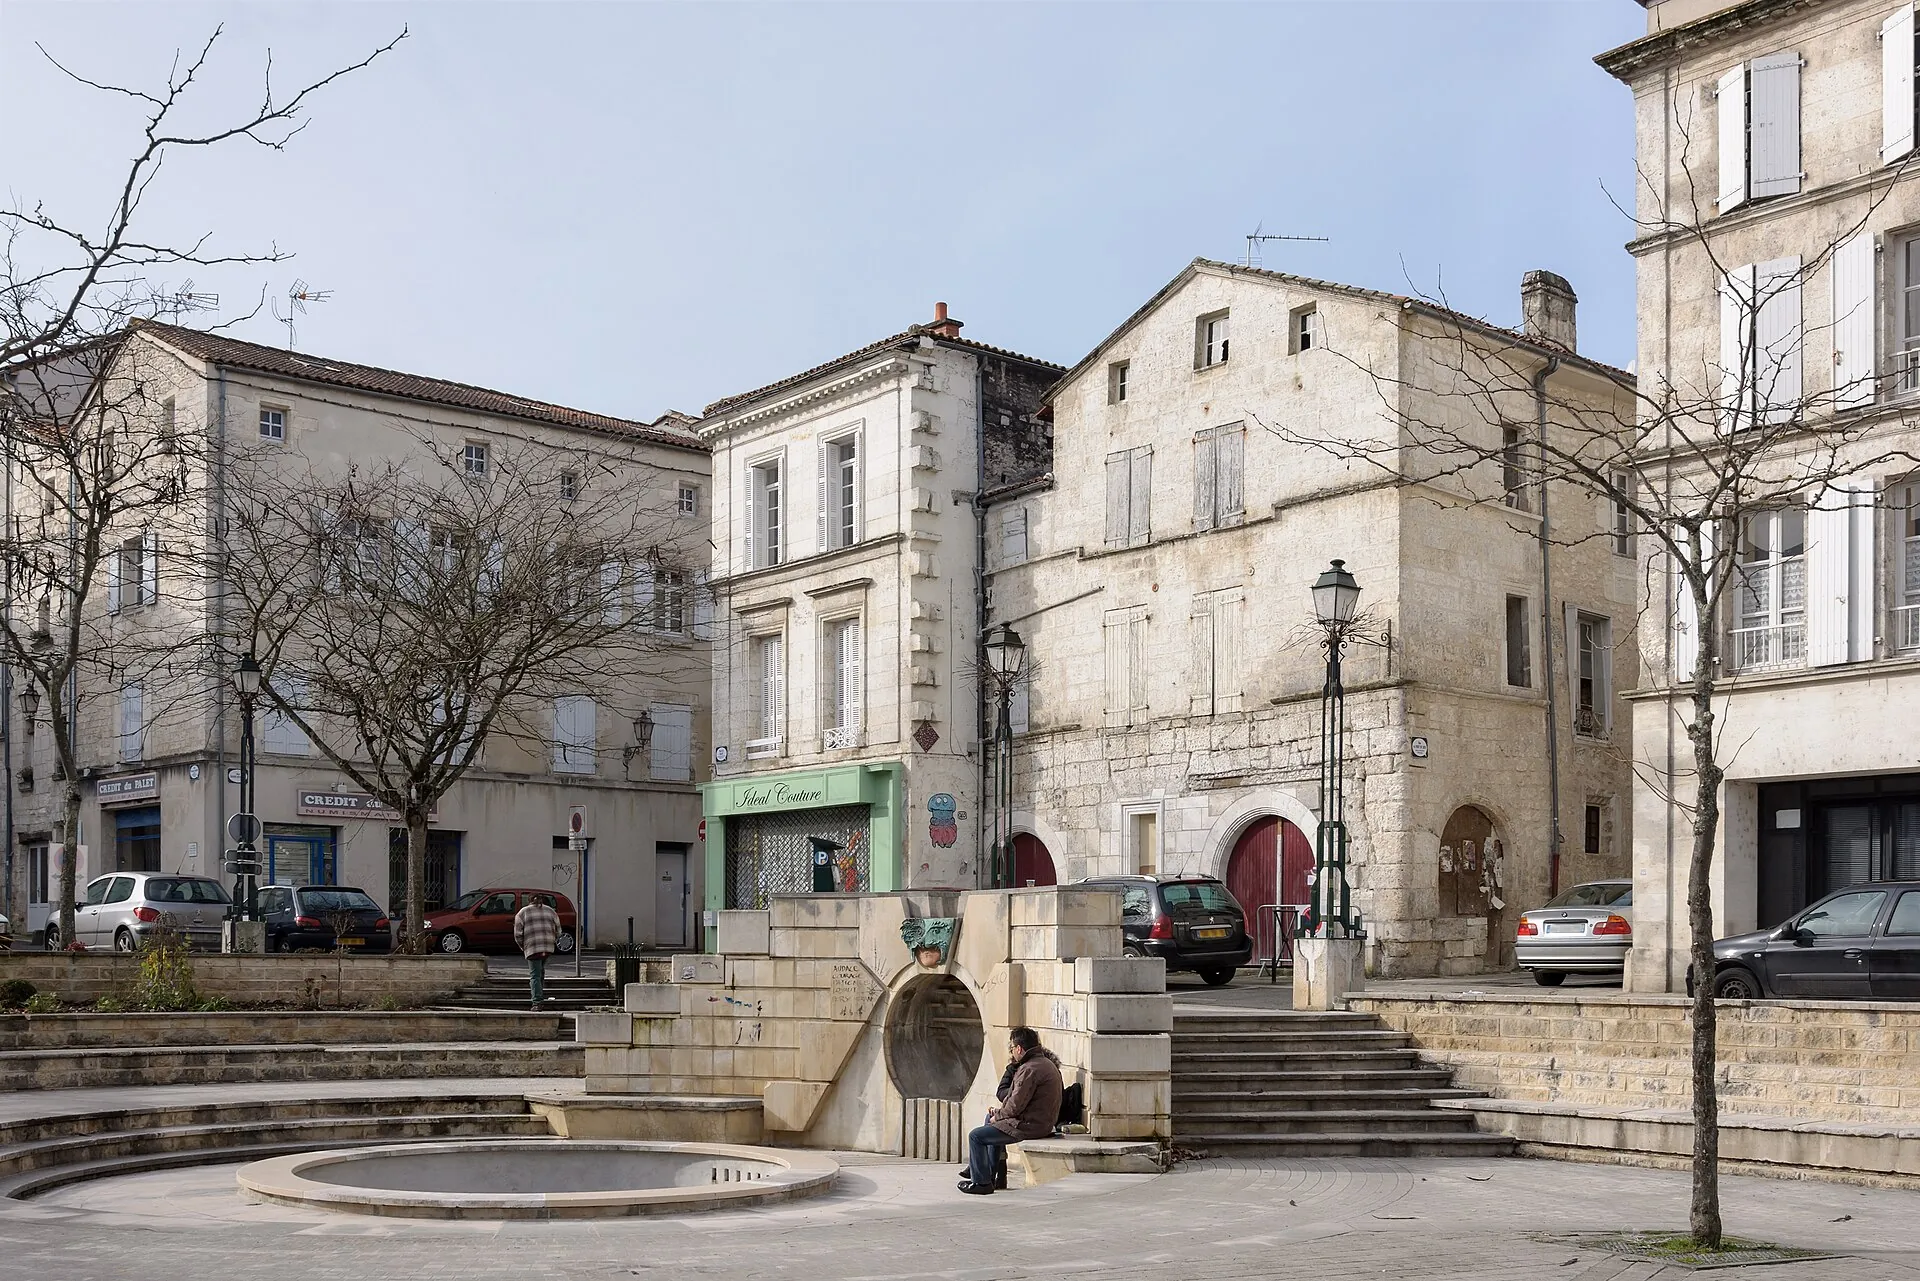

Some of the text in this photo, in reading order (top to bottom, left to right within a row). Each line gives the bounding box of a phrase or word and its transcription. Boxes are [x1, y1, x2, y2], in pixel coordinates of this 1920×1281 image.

[100, 778, 154, 794] CREDIT du PALET
[304, 795, 358, 807] CREDIT
[736, 782, 822, 808] Ideal Couture
[305, 808, 400, 818] NUMISMATI
